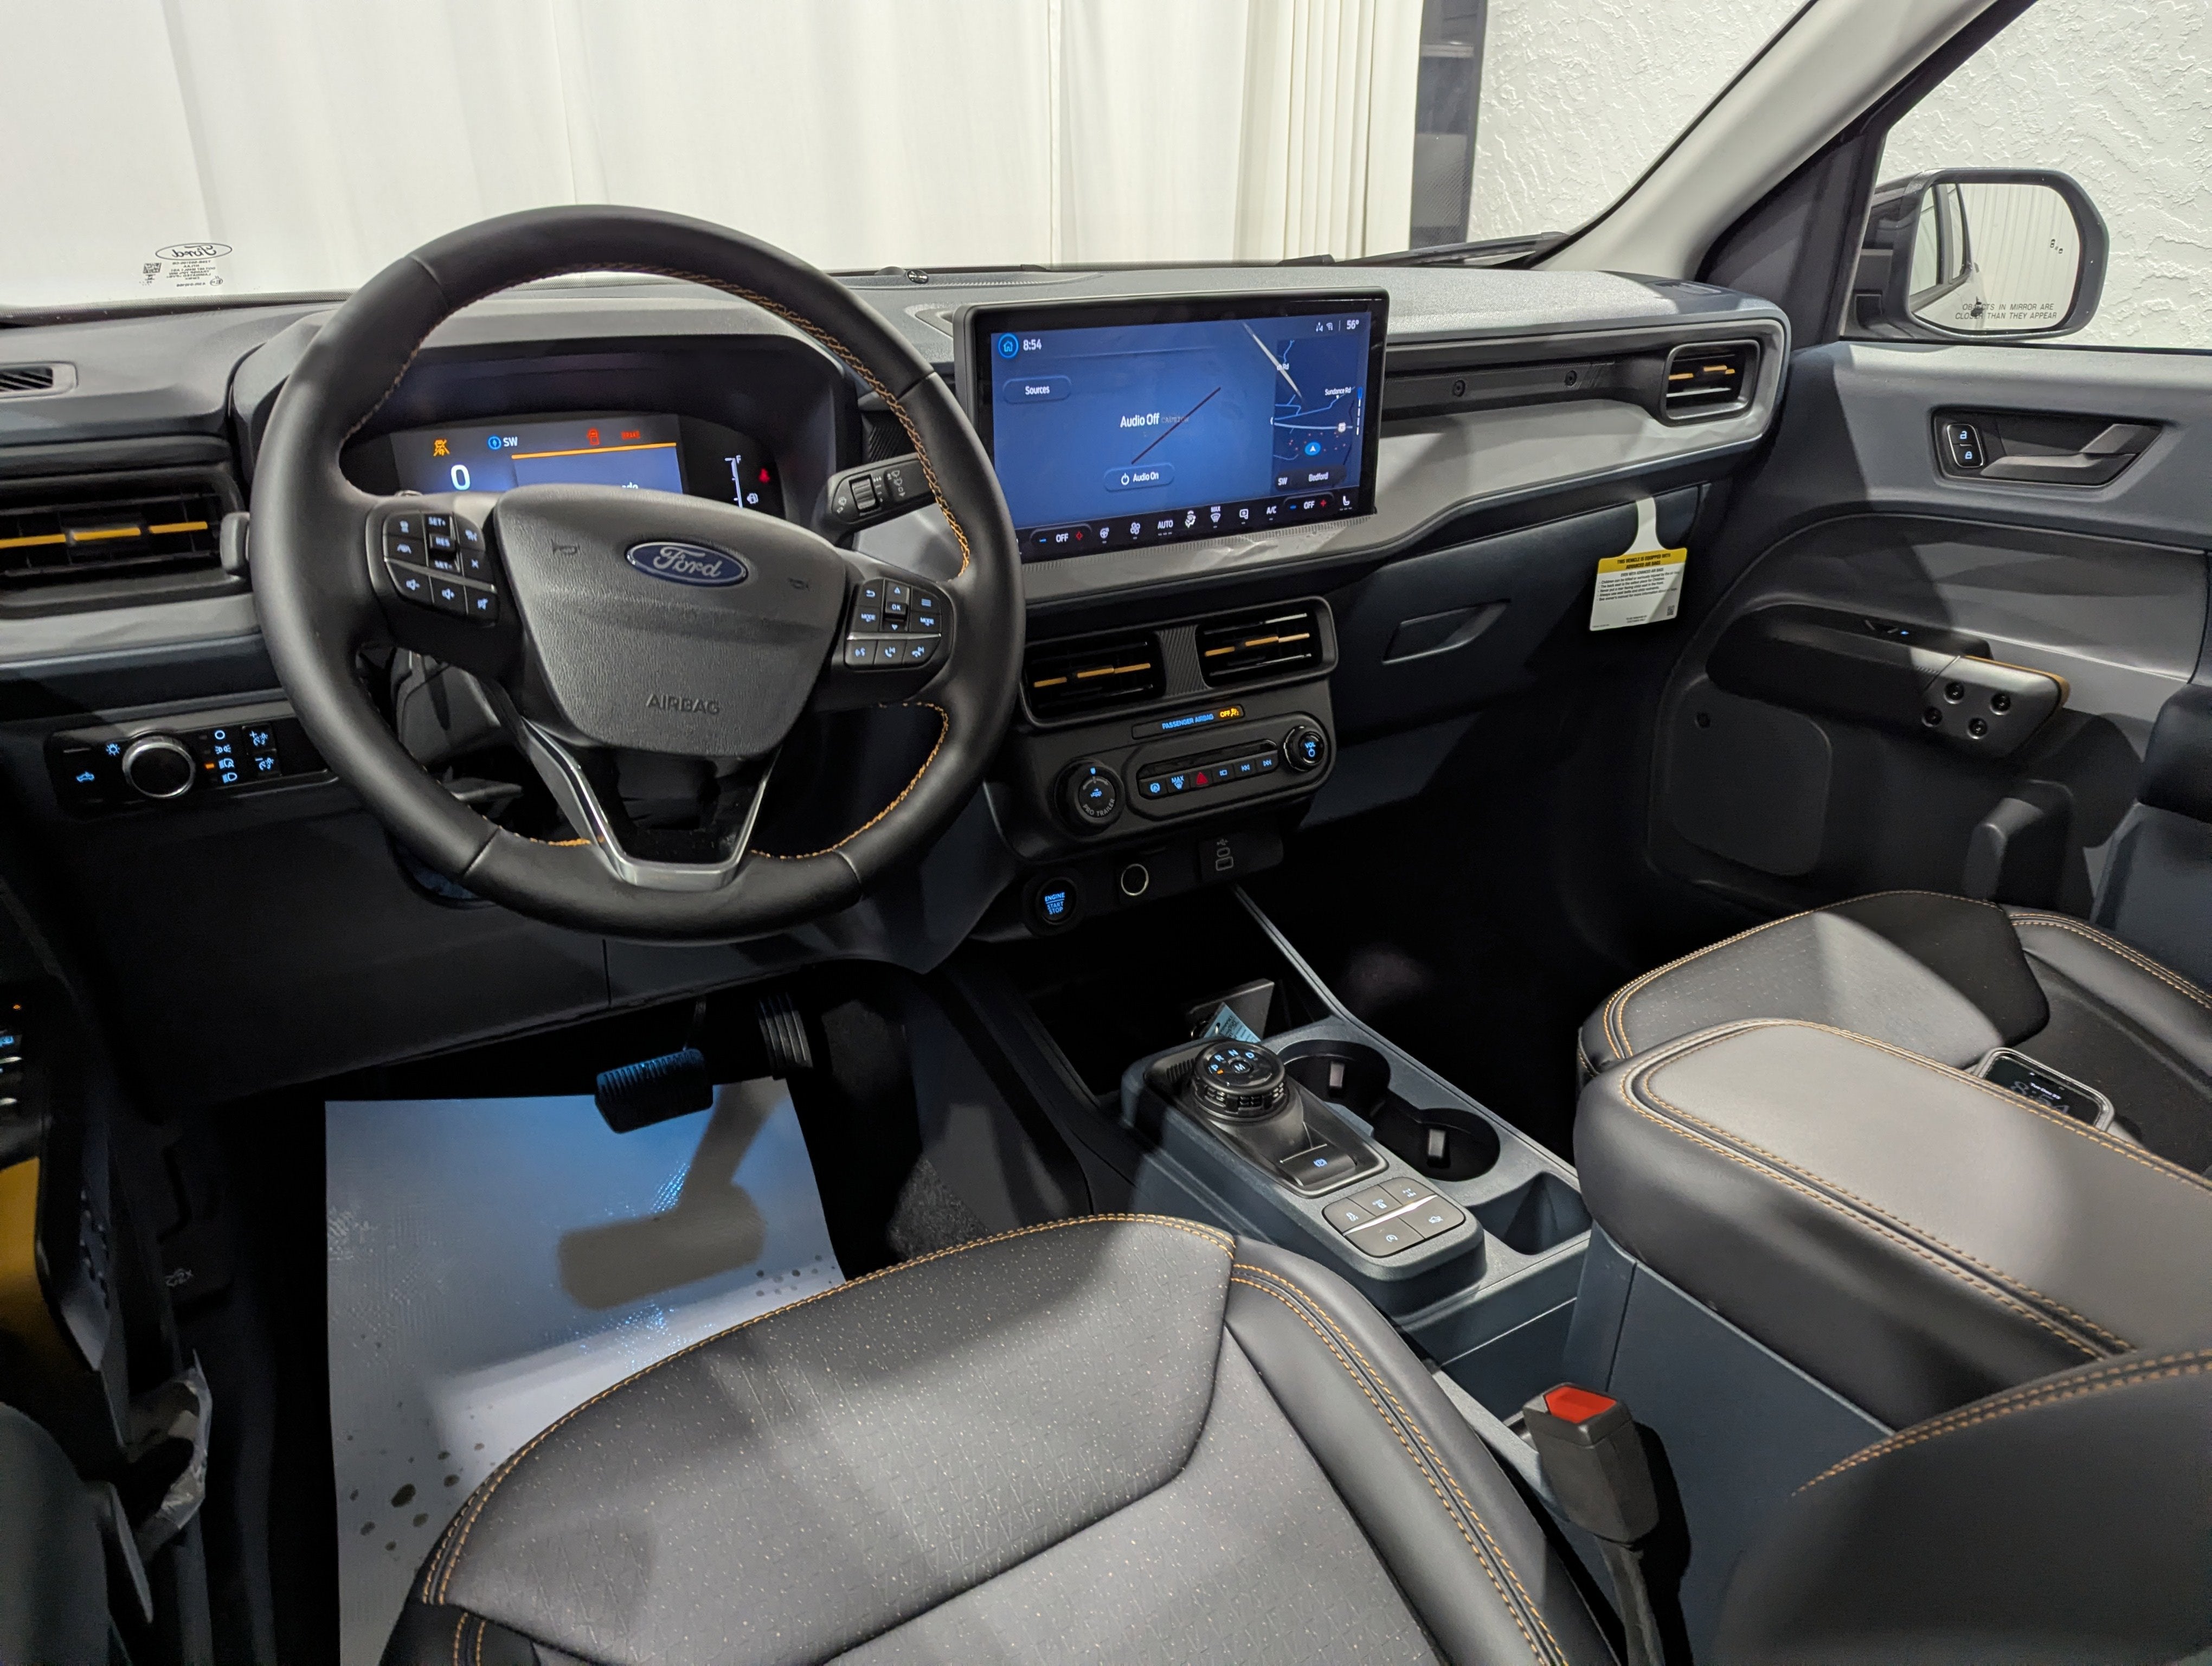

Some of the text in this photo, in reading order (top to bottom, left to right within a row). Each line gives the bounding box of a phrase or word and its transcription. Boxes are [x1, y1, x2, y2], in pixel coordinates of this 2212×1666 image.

[1023, 339, 1042, 351] 8:54
[1025, 386, 1050, 395] Sources
[1325, 387, 1345, 395] Sundance
[1120, 412, 1160, 427] Audio Off
[503, 437, 518, 447] SW
[736, 455, 741, 464] F
[451, 464, 471, 490] 0
[1133, 473, 1149, 482] Audio
[1278, 477, 1288, 486] SW
[1308, 472, 1328, 482] Bedford
[1266, 505, 1276, 515] A/C
[1303, 500, 1315, 510] OFF
[1158, 519, 1173, 529] AUTO
[1056, 533, 1069, 543] OFF
[653, 546, 722, 578] Ford
[646, 693, 721, 715] AIRBAG
[1162, 717, 1194, 729] PASSENGER
[1195, 713, 1214, 722] AIRBAG
[1083, 798, 1115, 816] PRO TRAILER
[1045, 892, 1065, 902] ENGINE
[1047, 901, 1064, 910] START
[1049, 907, 1063, 915] STOP
[1234, 1063, 1246, 1072] M
